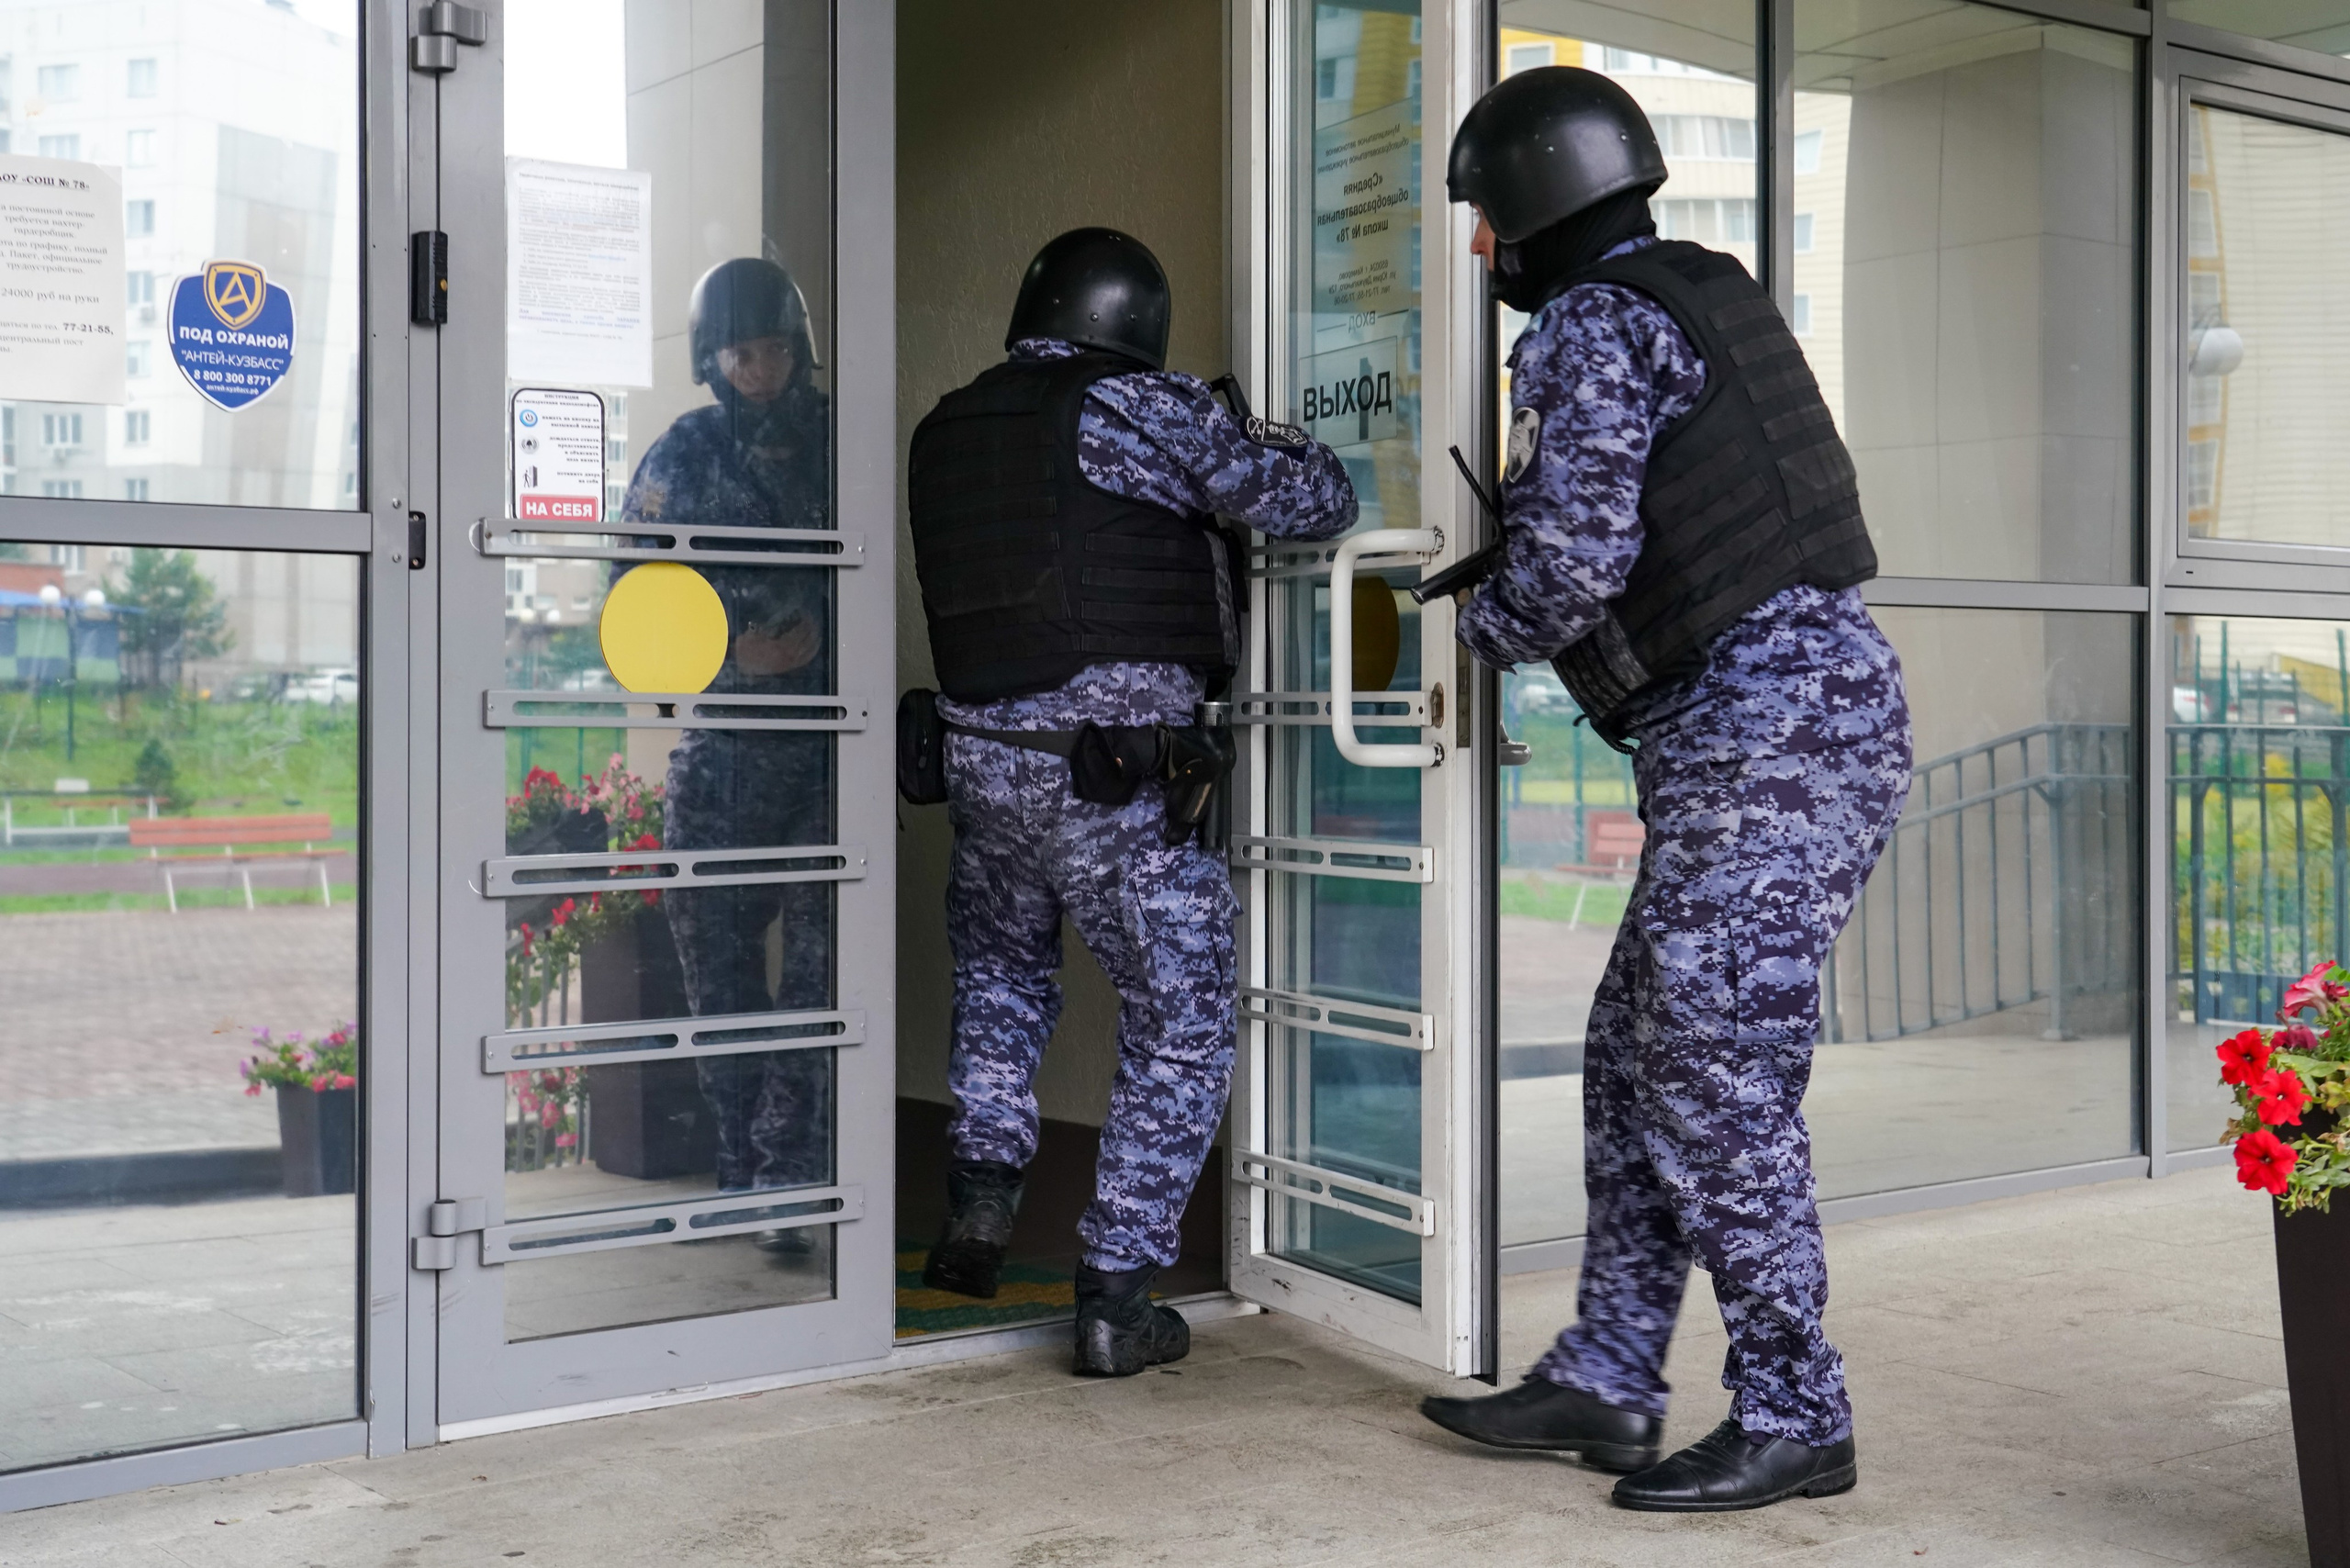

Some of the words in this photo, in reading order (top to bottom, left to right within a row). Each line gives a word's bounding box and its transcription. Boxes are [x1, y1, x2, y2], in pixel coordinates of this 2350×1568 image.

[22, 174, 55, 185] «СОШ
[58, 177, 70, 188] №
[73, 179, 90, 190] 78»
[9, 204, 63, 216] постоянной
[65, 209, 95, 219] основе
[5, 215, 49, 225] требуется
[30, 241, 72, 252] графику,
[74, 245, 108, 255] полный
[42, 253, 103, 265] официальное
[2, 287, 34, 299] 24000
[37, 290, 56, 302] руб
[58, 293, 72, 301] на
[74, 294, 100, 304] руки
[62, 322, 114, 336] 77-21-55,
[179, 326, 214, 345] ПОД
[216, 330, 289, 350] ОХРАНОЙ
[181, 349, 285, 371] "АНТЕЙ-КУЗБАСС"
[194, 369, 201, 380] 8
[203, 370, 223, 383] 800
[225, 372, 245, 385] 300
[246, 374, 272, 386] 8771
[1304, 370, 1392, 422] ВЫХОД
[525, 501, 548, 516] НА
[552, 502, 593, 518] СЕБЯ
